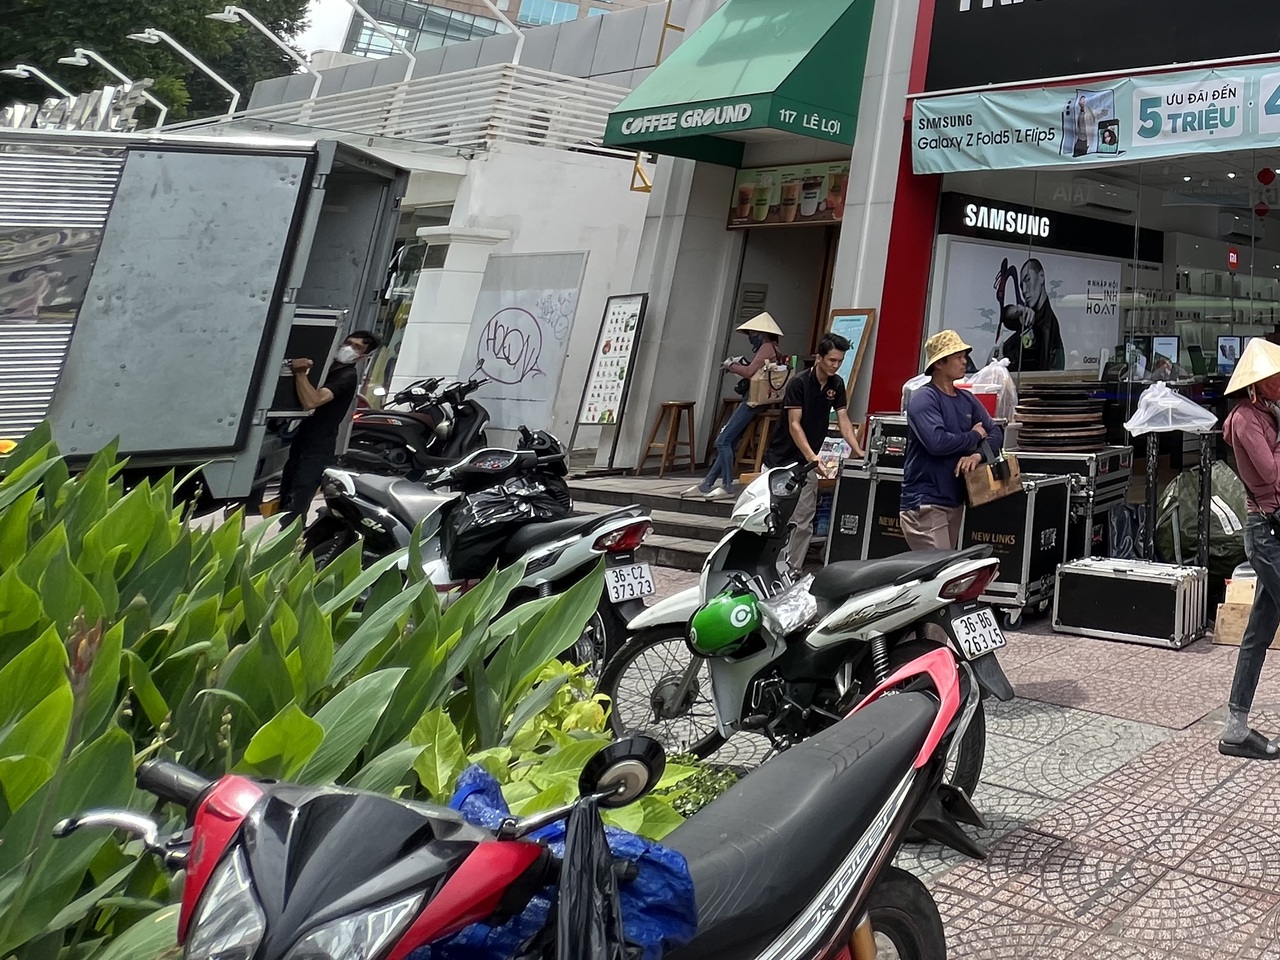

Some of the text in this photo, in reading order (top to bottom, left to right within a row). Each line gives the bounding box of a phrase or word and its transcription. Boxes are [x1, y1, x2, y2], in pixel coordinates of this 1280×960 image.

[1166, 83, 1237, 106] ƯU ĐÃI ĐẾN
[621, 102, 752, 135] COFFEE GROUND
[779, 108, 841, 136] 117 LÊ LỢI
[918, 114, 973, 131] SAMSUNG
[1136, 96, 1163, 139] 5
[1167, 102, 1236, 135] TRIỆU
[917, 127, 1056, 153] Galaxy Z Fold5 Z Flip5
[964, 203, 1050, 238] SAMSUNG
[1087, 288, 1118, 302] LINH
[879, 516, 895, 527] NEW
[971, 531, 1016, 545] NEW LINKS
[612, 565, 645, 584] 36-C2
[612, 579, 653, 600] 373.23
[960, 611, 992, 635] 36-B6
[964, 628, 1003, 657] 263.45
